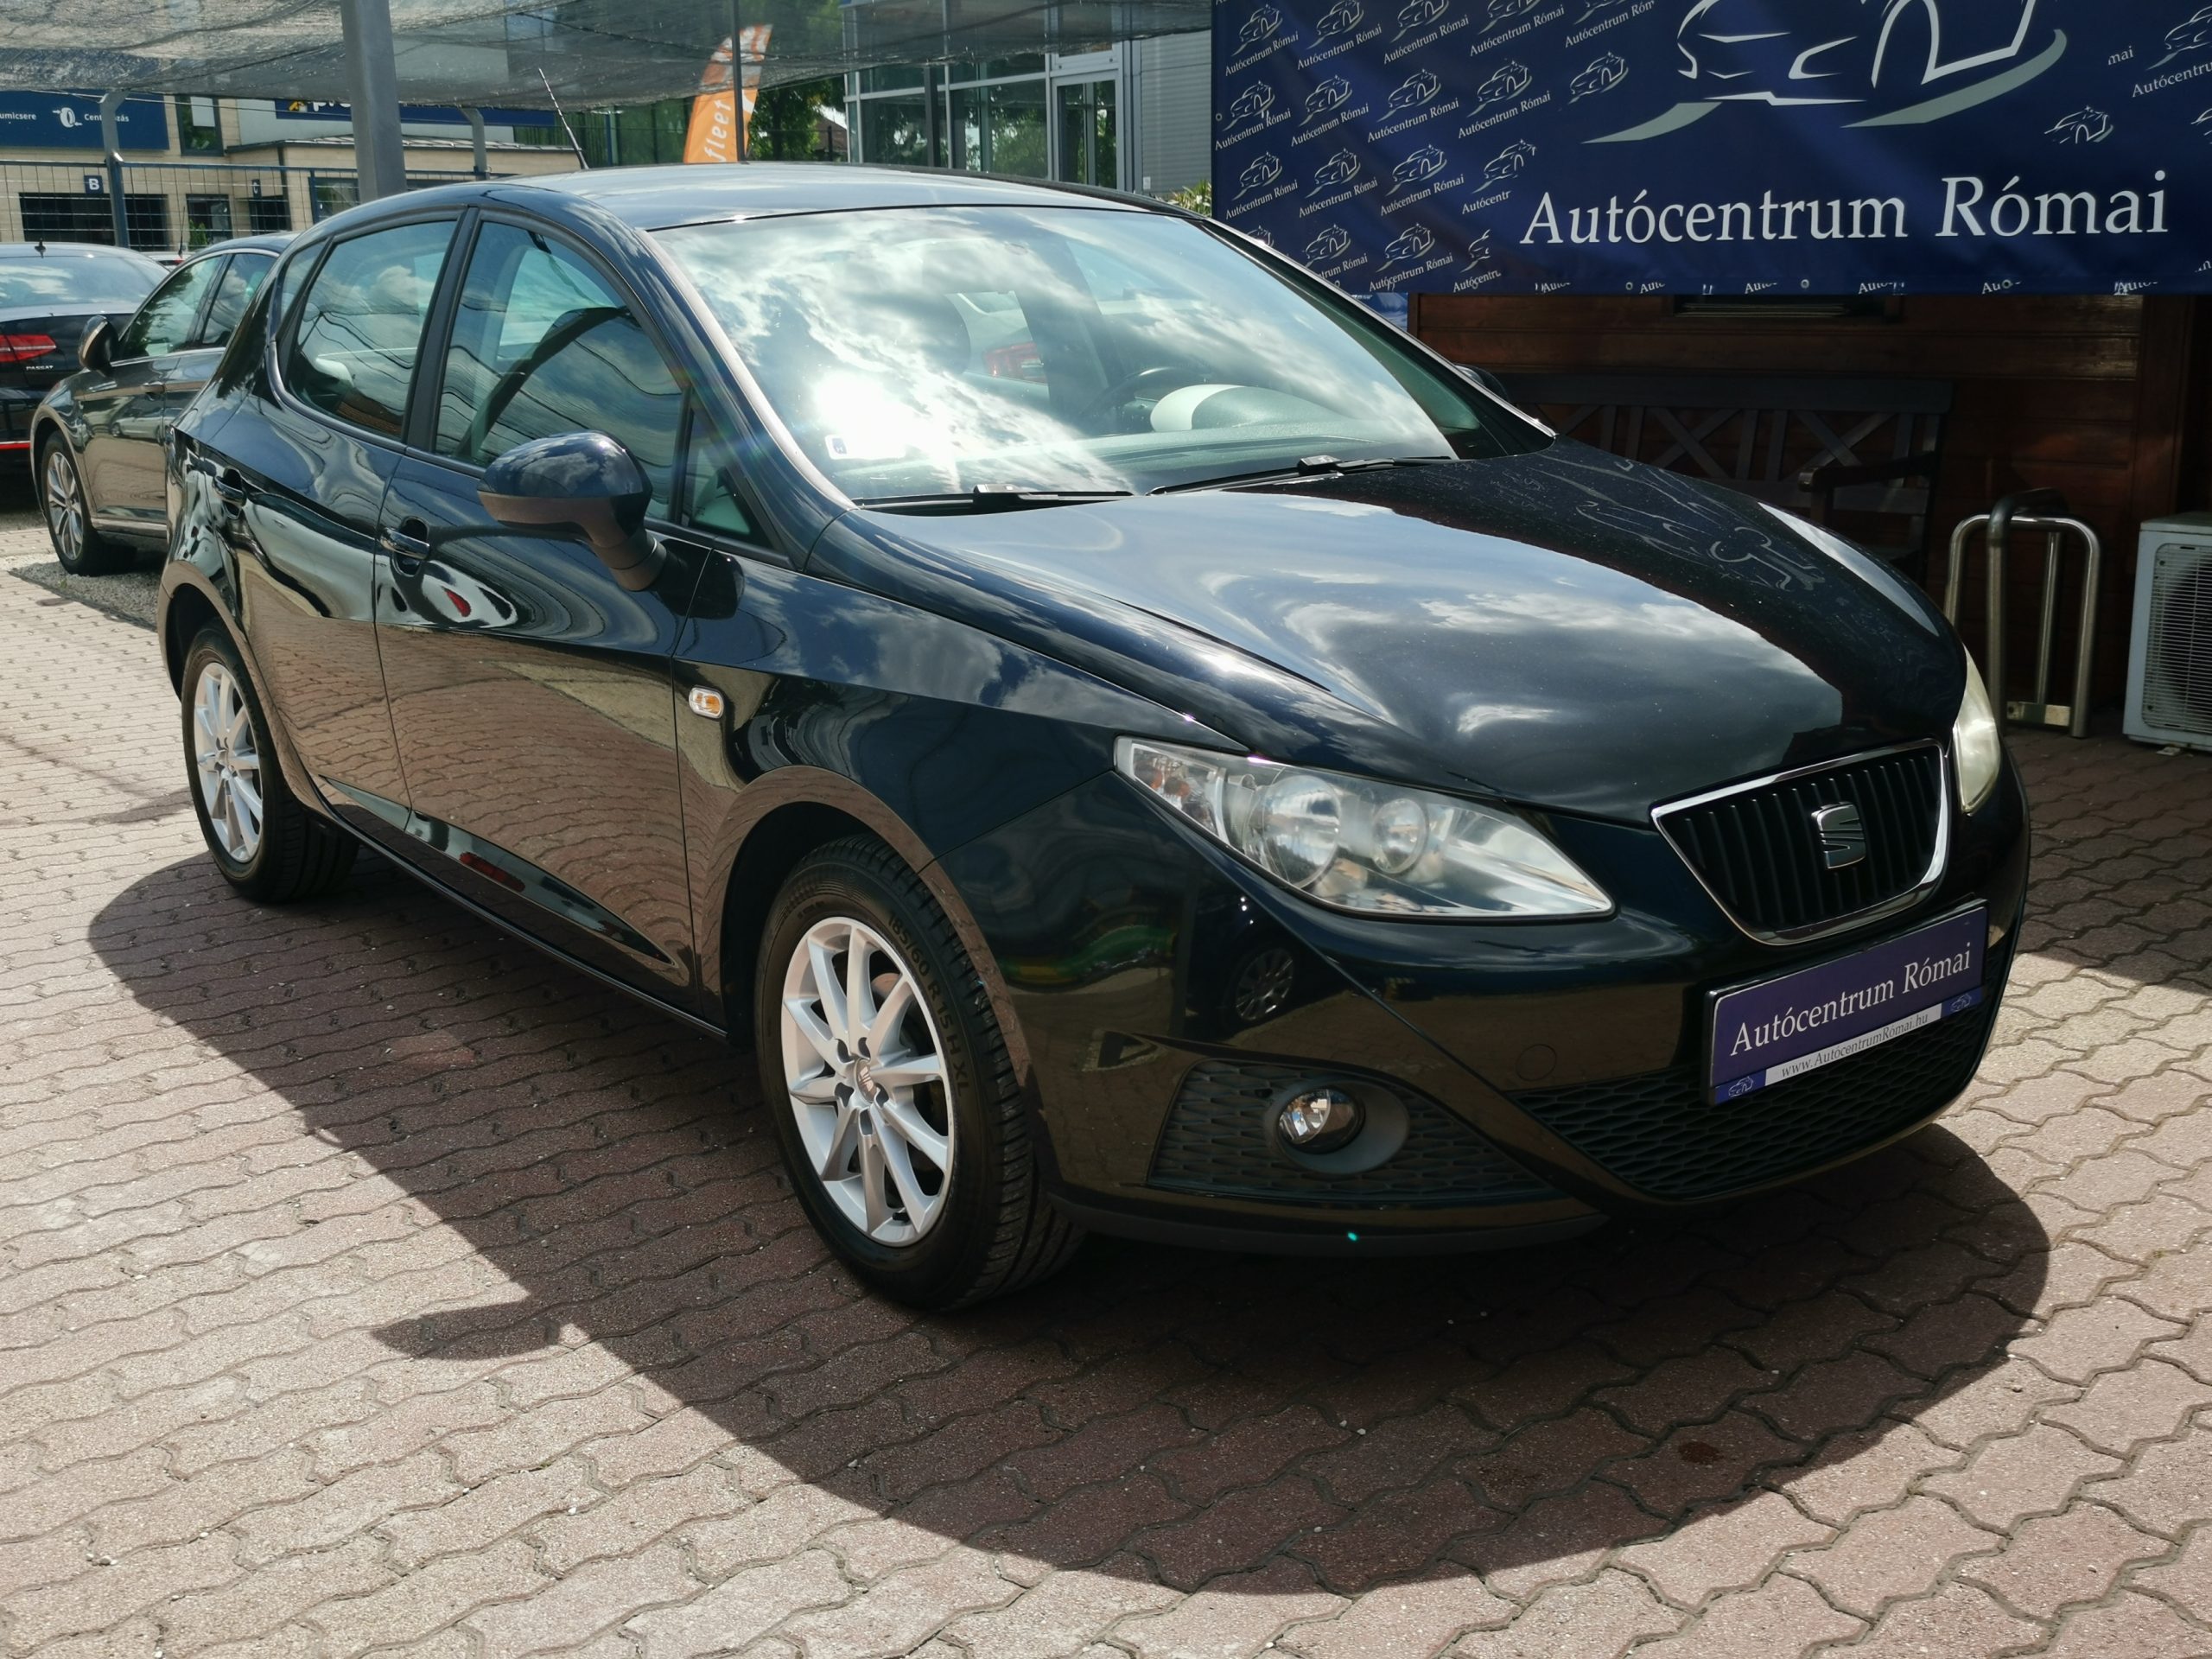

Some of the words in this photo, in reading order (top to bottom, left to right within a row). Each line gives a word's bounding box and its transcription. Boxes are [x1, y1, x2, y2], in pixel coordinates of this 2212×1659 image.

[1297, 41, 1355, 70] Autócentrum
[1356, 23, 1382, 45] Római
[1383, 31, 1438, 65] Autócentrum
[1440, 14, 1469, 35] Római
[1470, 22, 1532, 57] Autócentrum
[1533, 4, 1565, 28] Római
[1565, 12, 1630, 48] Autócentrum
[1225, 46, 1273, 77] Autócentrum
[1272, 31, 1299, 52] Római
[2107, 45, 2134, 66] mai
[1215, 123, 1264, 151] Autócentrum
[1266, 108, 1292, 128] Római
[1291, 118, 1339, 147] Autócentrum
[1340, 102, 1370, 123] Római
[1367, 114, 1427, 143] Autócentrum
[1429, 98, 1459, 119] Római
[1459, 107, 1519, 139] Autócentrum
[1520, 90, 1552, 113] Római
[89, 178, 100, 190] B
[1226, 192, 1273, 220] Autócentrum
[1274, 179, 1299, 199] Római
[1299, 190, 1353, 219] Autócentrum
[1353, 175, 1379, 196] Római
[1381, 188, 1432, 216] Autócentrum
[1433, 173, 1465, 194] Római
[1520, 188, 1909, 245] Autócentrum
[1935, 170, 2169, 238] Római
[1343, 252, 1369, 272] Római
[1369, 266, 1425, 292] Autócentrum
[1426, 252, 1454, 272] Római
[1730, 979, 1894, 1057] Autócentrum
[1902, 942, 1971, 994] Római
